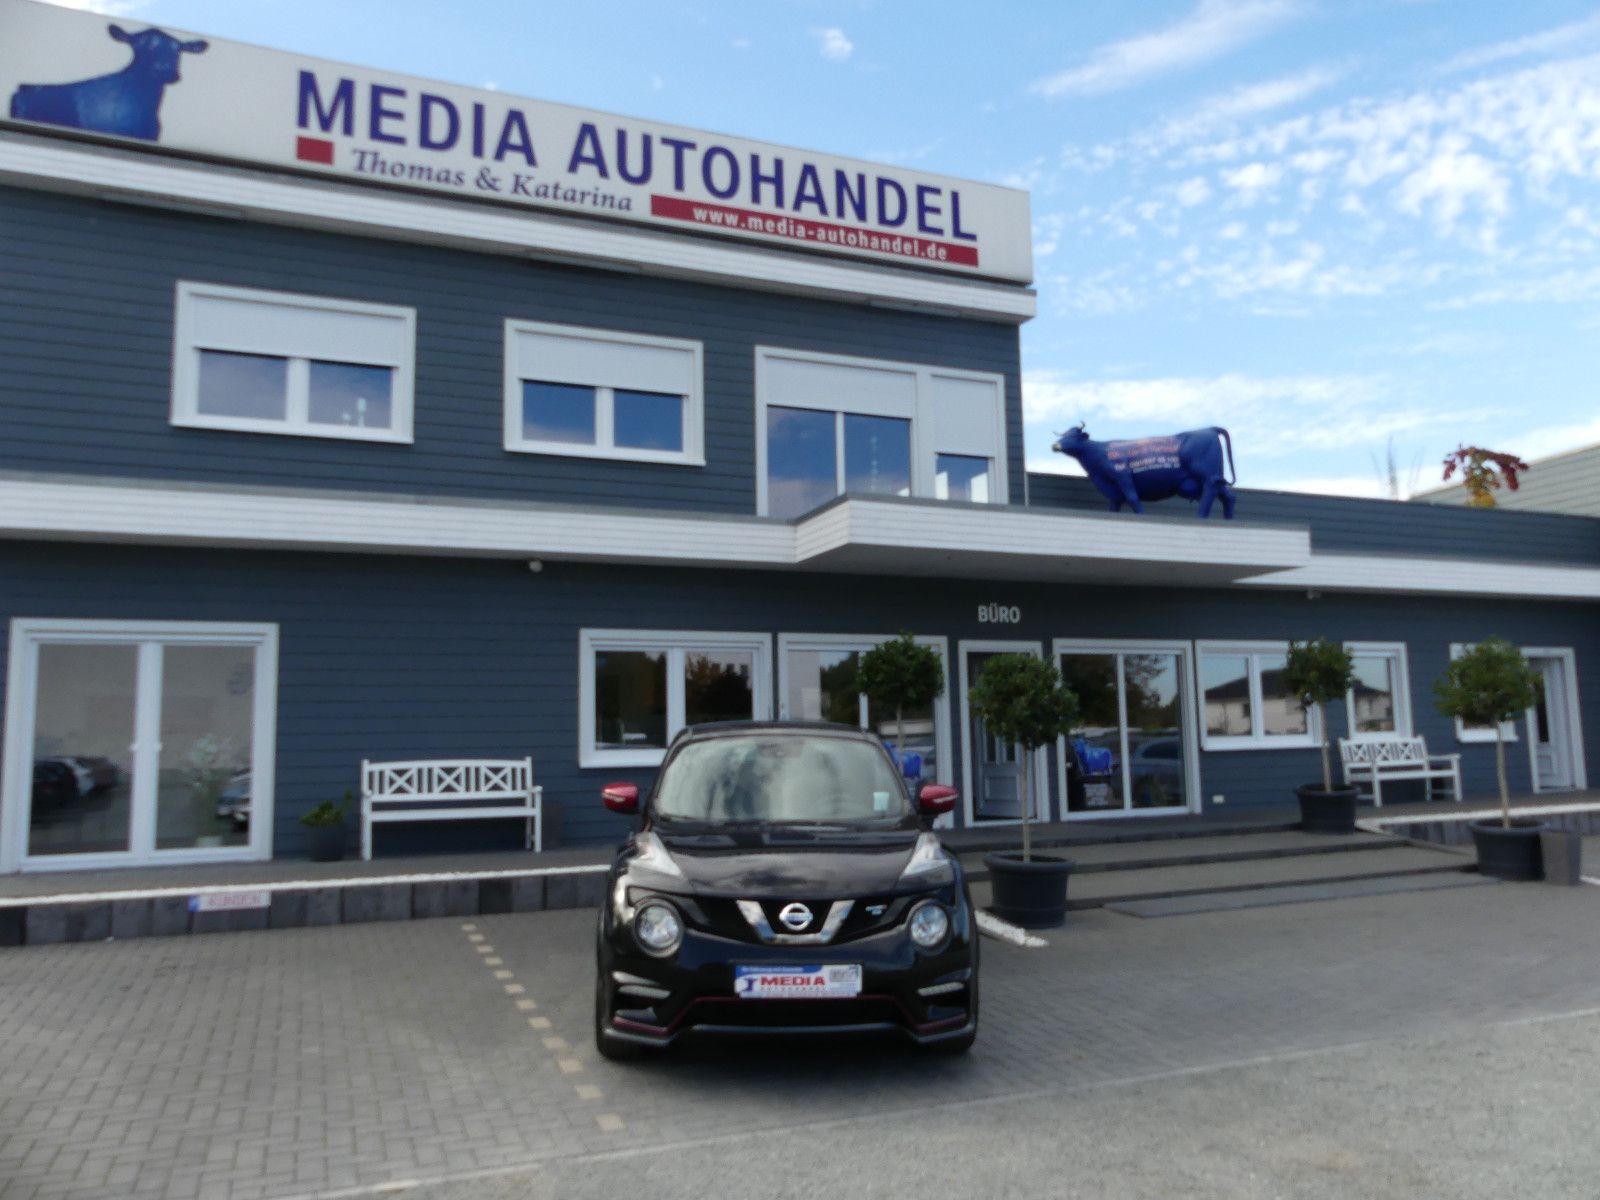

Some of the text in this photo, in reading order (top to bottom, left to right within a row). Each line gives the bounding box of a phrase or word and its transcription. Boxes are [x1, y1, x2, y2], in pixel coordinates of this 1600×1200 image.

[297, 69, 978, 242] MEDIA AUTOHANDEL
[352, 149, 633, 212] Thomas & Katarina
[692, 206, 948, 261] www.media-autohandel.de
[977, 602, 1021, 624] BÜRO
[760, 975, 825, 986] MEDIA
